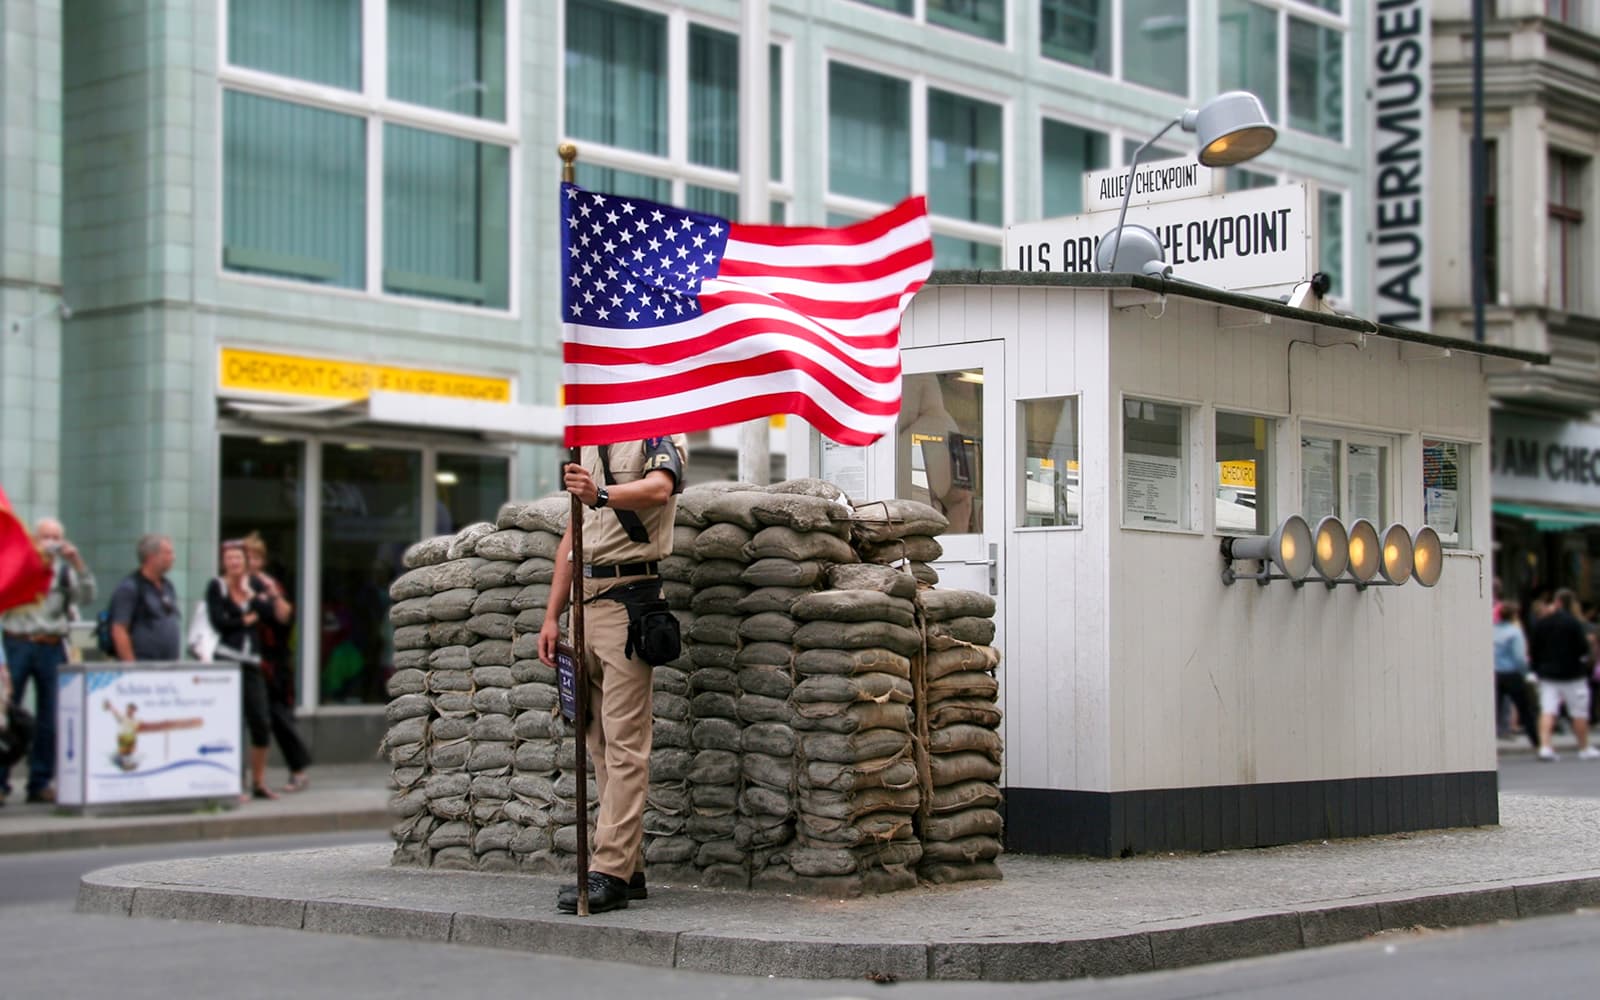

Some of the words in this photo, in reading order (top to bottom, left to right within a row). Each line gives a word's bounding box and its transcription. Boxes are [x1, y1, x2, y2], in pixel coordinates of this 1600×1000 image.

[1135, 163, 1198, 194] CHECKPOINT
[1377, 0, 1421, 326] AUERMUSE
[1156, 208, 1291, 265] HECKPOINT
[227, 356, 325, 389] CHECKPOINT
[329, 367, 389, 391] CHARE
